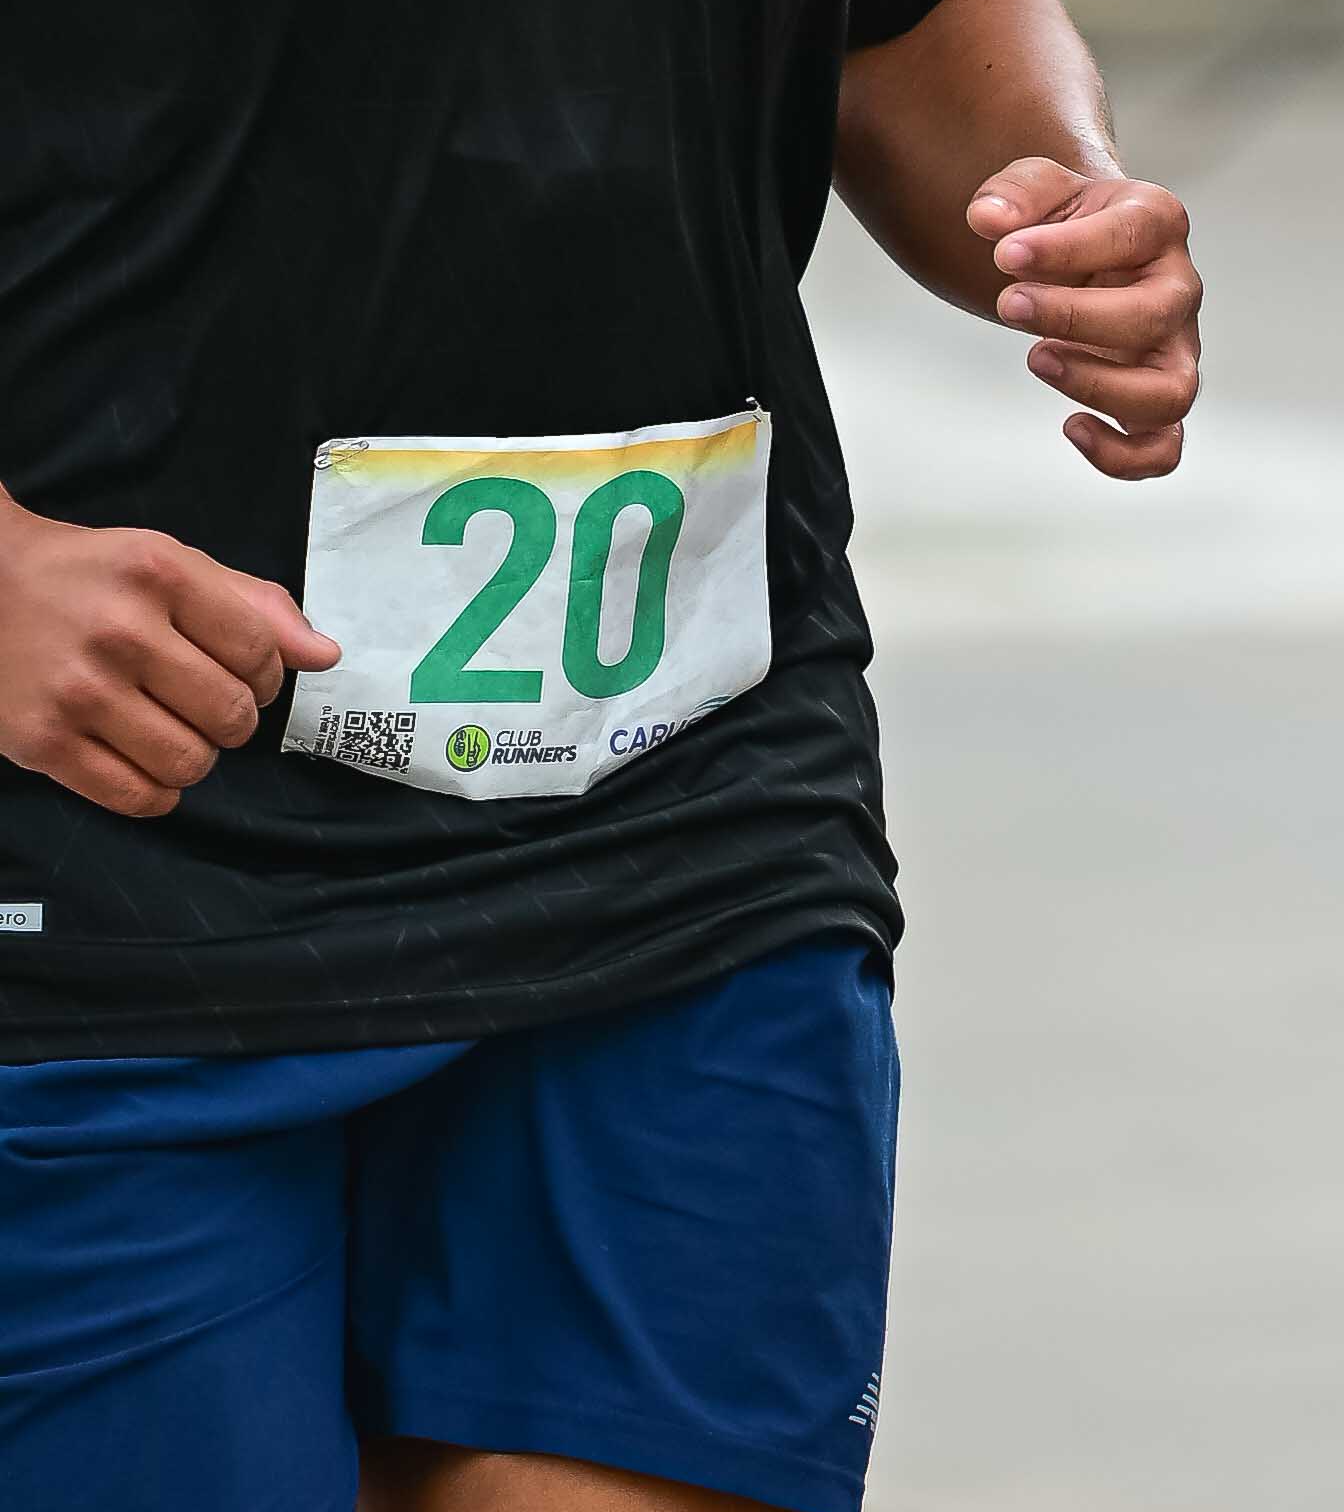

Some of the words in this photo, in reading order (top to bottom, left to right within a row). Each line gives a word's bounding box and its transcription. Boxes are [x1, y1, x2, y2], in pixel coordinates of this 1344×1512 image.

[409, 469, 685, 704] 20
[496, 730, 542, 747] CLUB
[491, 745, 577, 764] RUNNER'S
